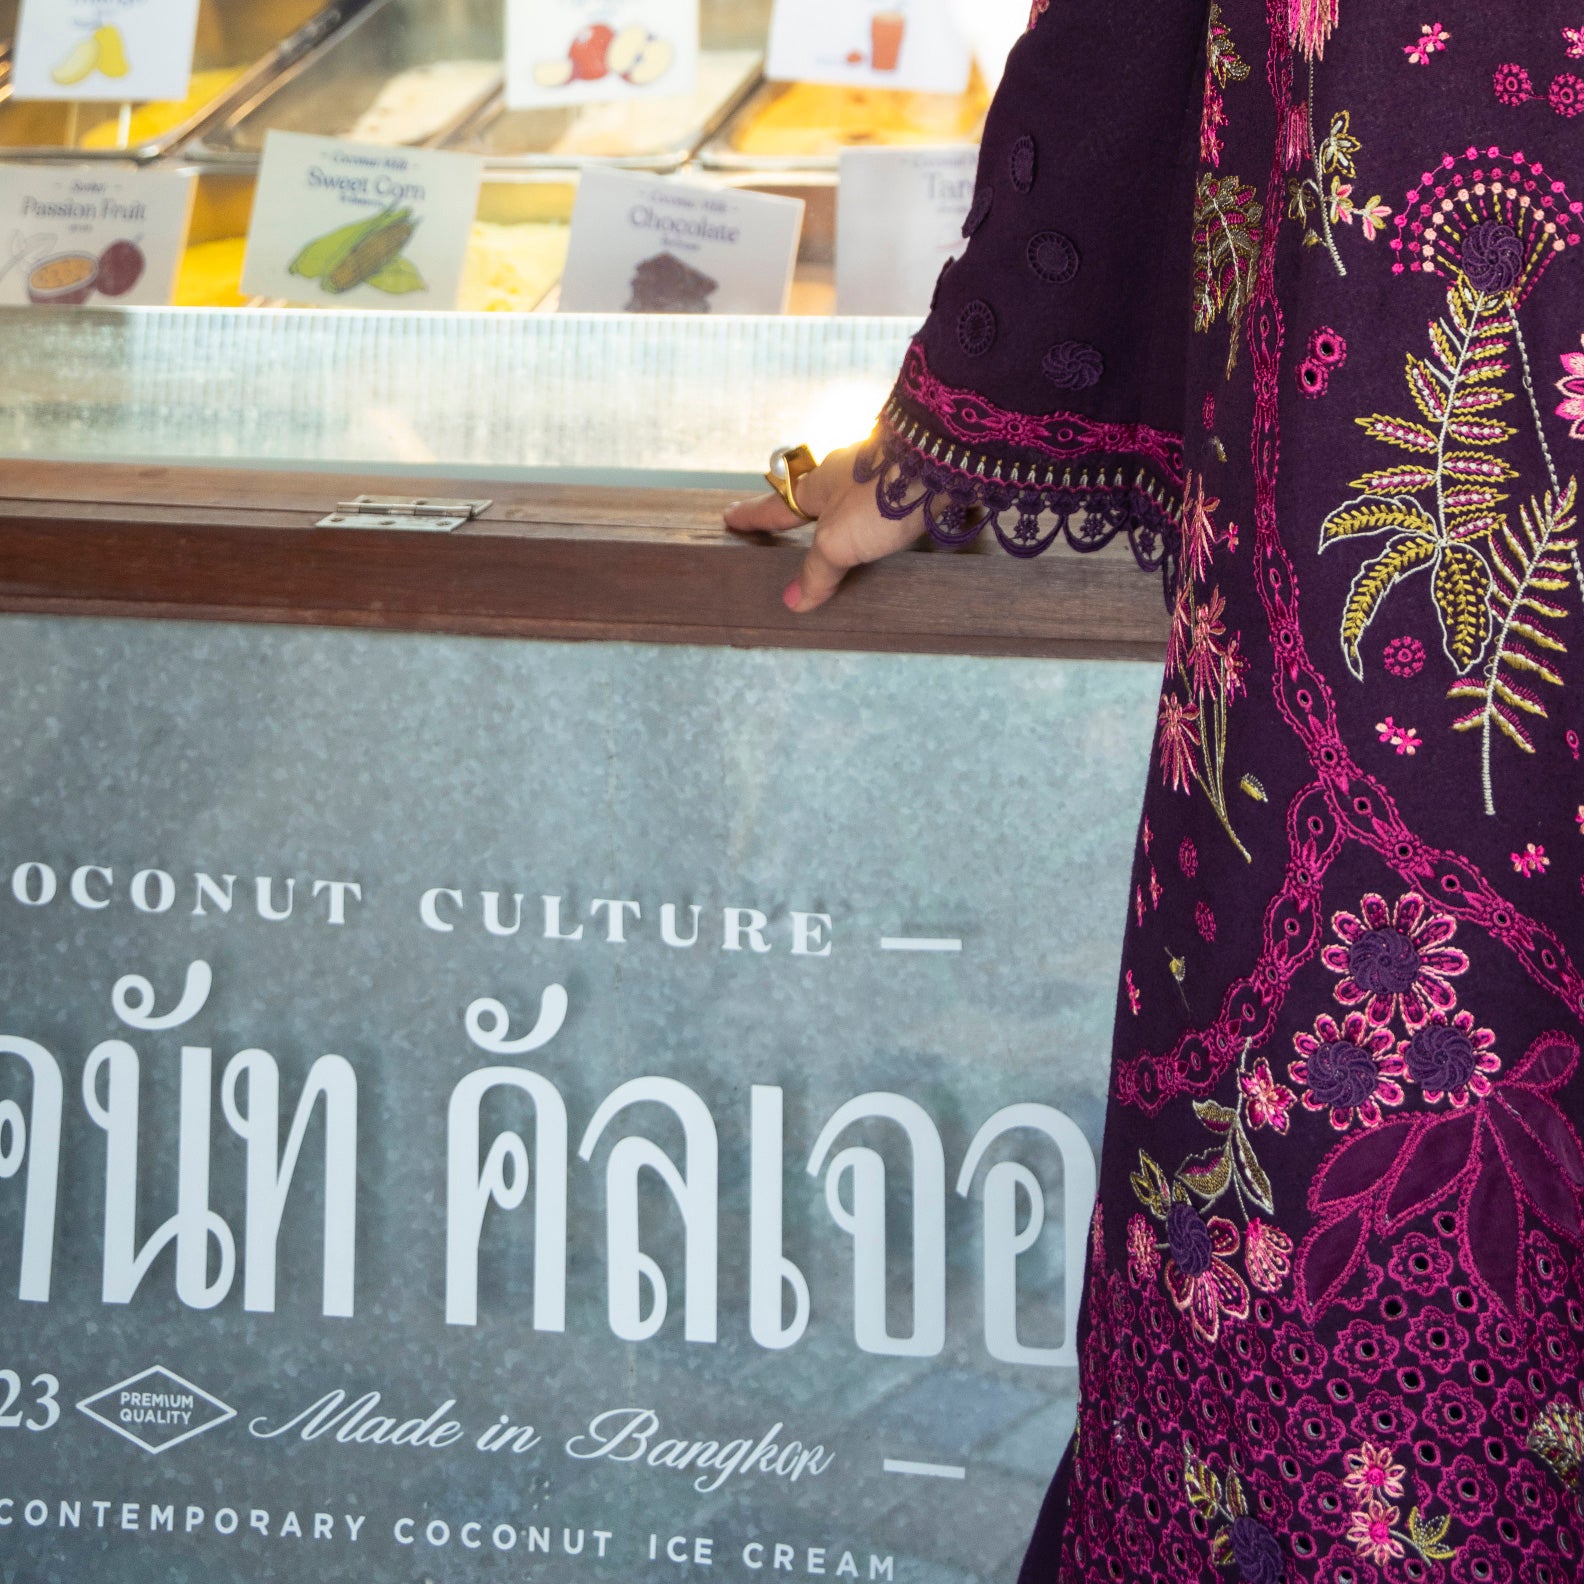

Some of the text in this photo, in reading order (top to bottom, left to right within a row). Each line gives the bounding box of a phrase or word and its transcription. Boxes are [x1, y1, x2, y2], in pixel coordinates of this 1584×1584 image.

[307, 166, 370, 194] Sweet
[374, 174, 428, 201] Corn
[22, 195, 147, 222] Passion Fruit
[628, 203, 742, 244] Chocolate
[12, 862, 833, 957] OCONUT CULTURE
[119, 1392, 195, 1410] PREMIUM
[119, 1407, 193, 1426] QUALITY
[249, 1389, 464, 1449] Made
[476, 1414, 542, 1454] in
[0, 1498, 895, 1582] CONTEMPORARY COCONUT ICE CREAM
